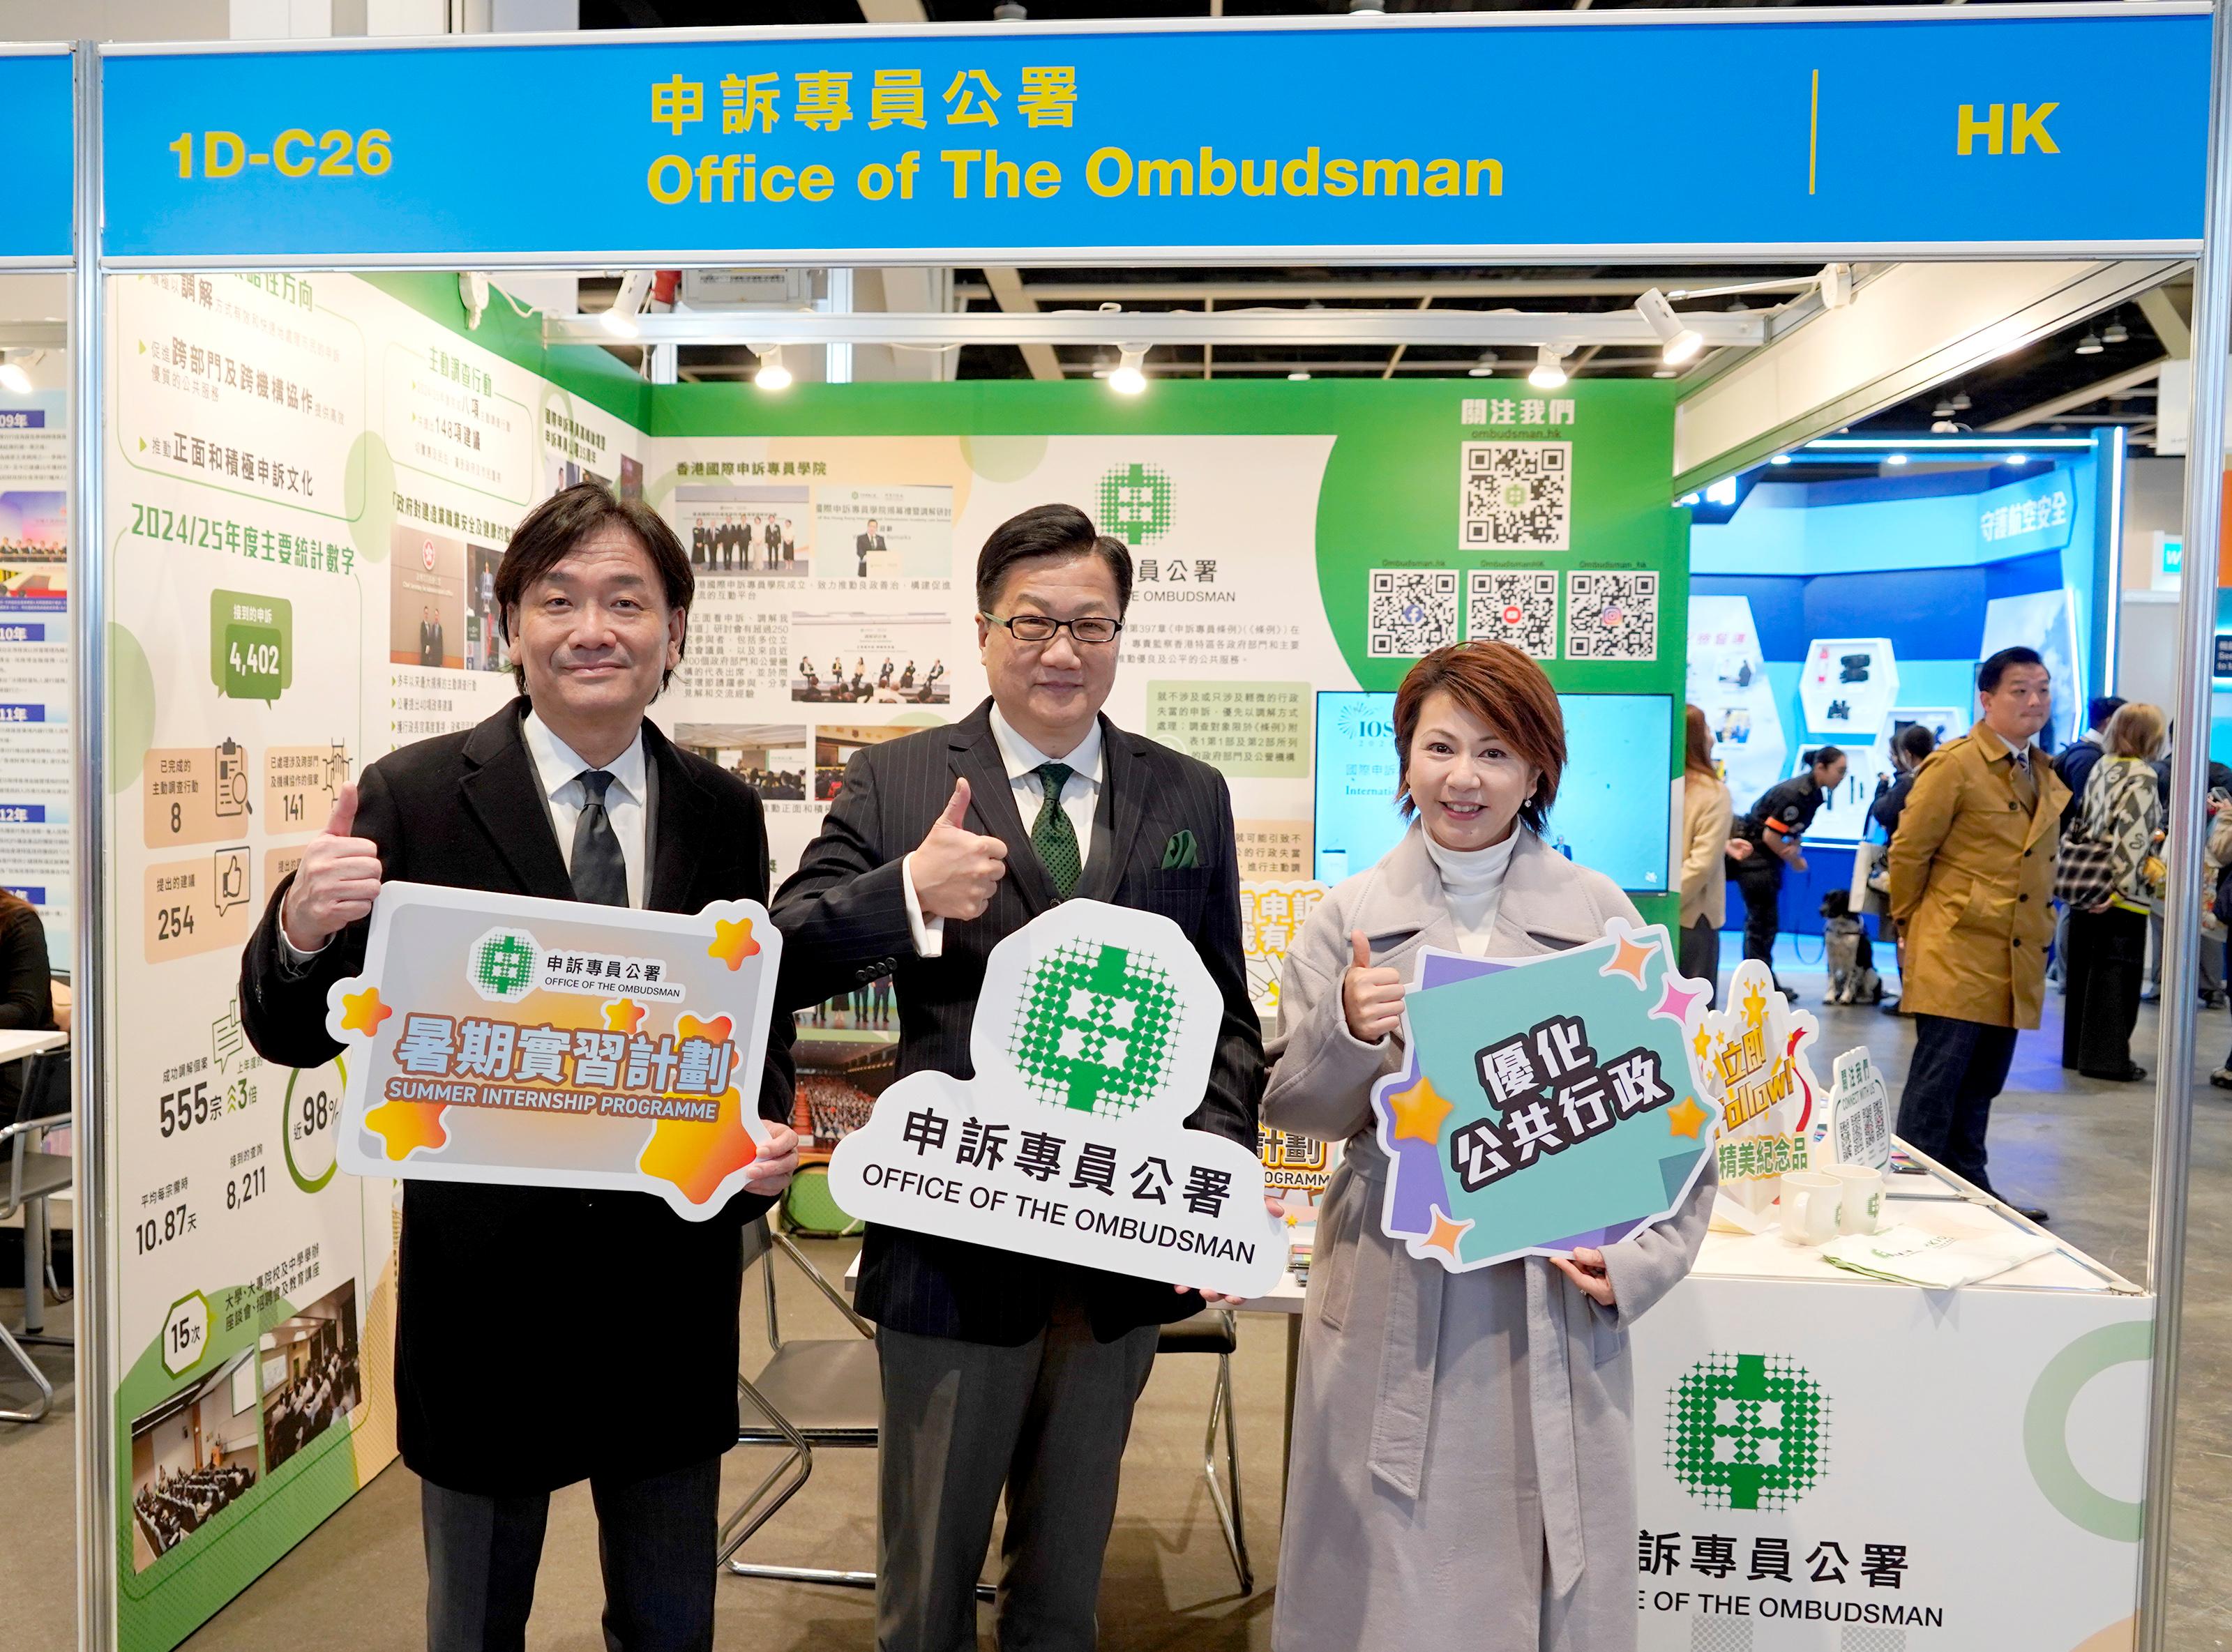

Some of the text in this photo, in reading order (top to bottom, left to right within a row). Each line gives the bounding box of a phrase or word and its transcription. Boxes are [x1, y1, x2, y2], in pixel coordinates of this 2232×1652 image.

[651, 66, 1078, 135] 申訴專員公署
[1956, 103, 2061, 155] HK
[169, 128, 393, 179] 1D-C26
[647, 146, 1503, 204] Office of The Ombudsman
[1461, 398, 1576, 425] 關注我們
[1471, 427, 1562, 439] ombudsman.hk
[151, 431, 314, 497] 推動正面和積極申訴文化
[675, 460, 828, 477] 香港國際申訴專員學院
[131, 502, 356, 576] 2024/25年度主要統計數字
[1137, 559, 1218, 583] 員公署
[232, 603, 273, 625] 接到的申訴
[694, 591, 757, 600] 流的互動平台
[1143, 591, 1236, 603] OMBUDSMAN
[229, 642, 280, 676] 4,402
[1359, 720, 1394, 738] IOS
[160, 758, 192, 773] 已完成的
[152, 779, 199, 796] 主動調查行動
[170, 801, 182, 834] 8
[282, 793, 304, 822] 141
[156, 873, 196, 893] 提出的建議
[158, 904, 195, 941] 254
[544, 977, 681, 998] OFFICE OF THE OMBUDSMAN
[545, 954, 661, 984] 申訴專員公署
[162, 1056, 208, 1084] 成功調解個案
[397, 1015, 731, 1095] 暑期實習計劃
[1481, 1022, 1591, 1103] 優化
[1721, 1026, 1767, 1087] 立即
[160, 1082, 223, 1138] 555宗
[389, 1080, 717, 1121] SUMMER INTERNSHIP PROGRAMME
[1458, 1054, 1667, 1185] 公共行政
[903, 1105, 1232, 1218] 申訴專員公署
[1718, 1137, 1808, 1180] 精美紀念品
[227, 1165, 266, 1211] 8,211
[136, 1204, 197, 1256] 10.87天
[862, 1162, 1256, 1264] OFFICE OF THE OMBUDSMAN
[170, 1317, 201, 1354] 15次
[1638, 1529, 1909, 1589] 訴專員公署
[1654, 1590, 1689, 1612] OF
[1698, 1593, 1750, 1616] THE
[1759, 1597, 1944, 1628] OMBUDSMAN
